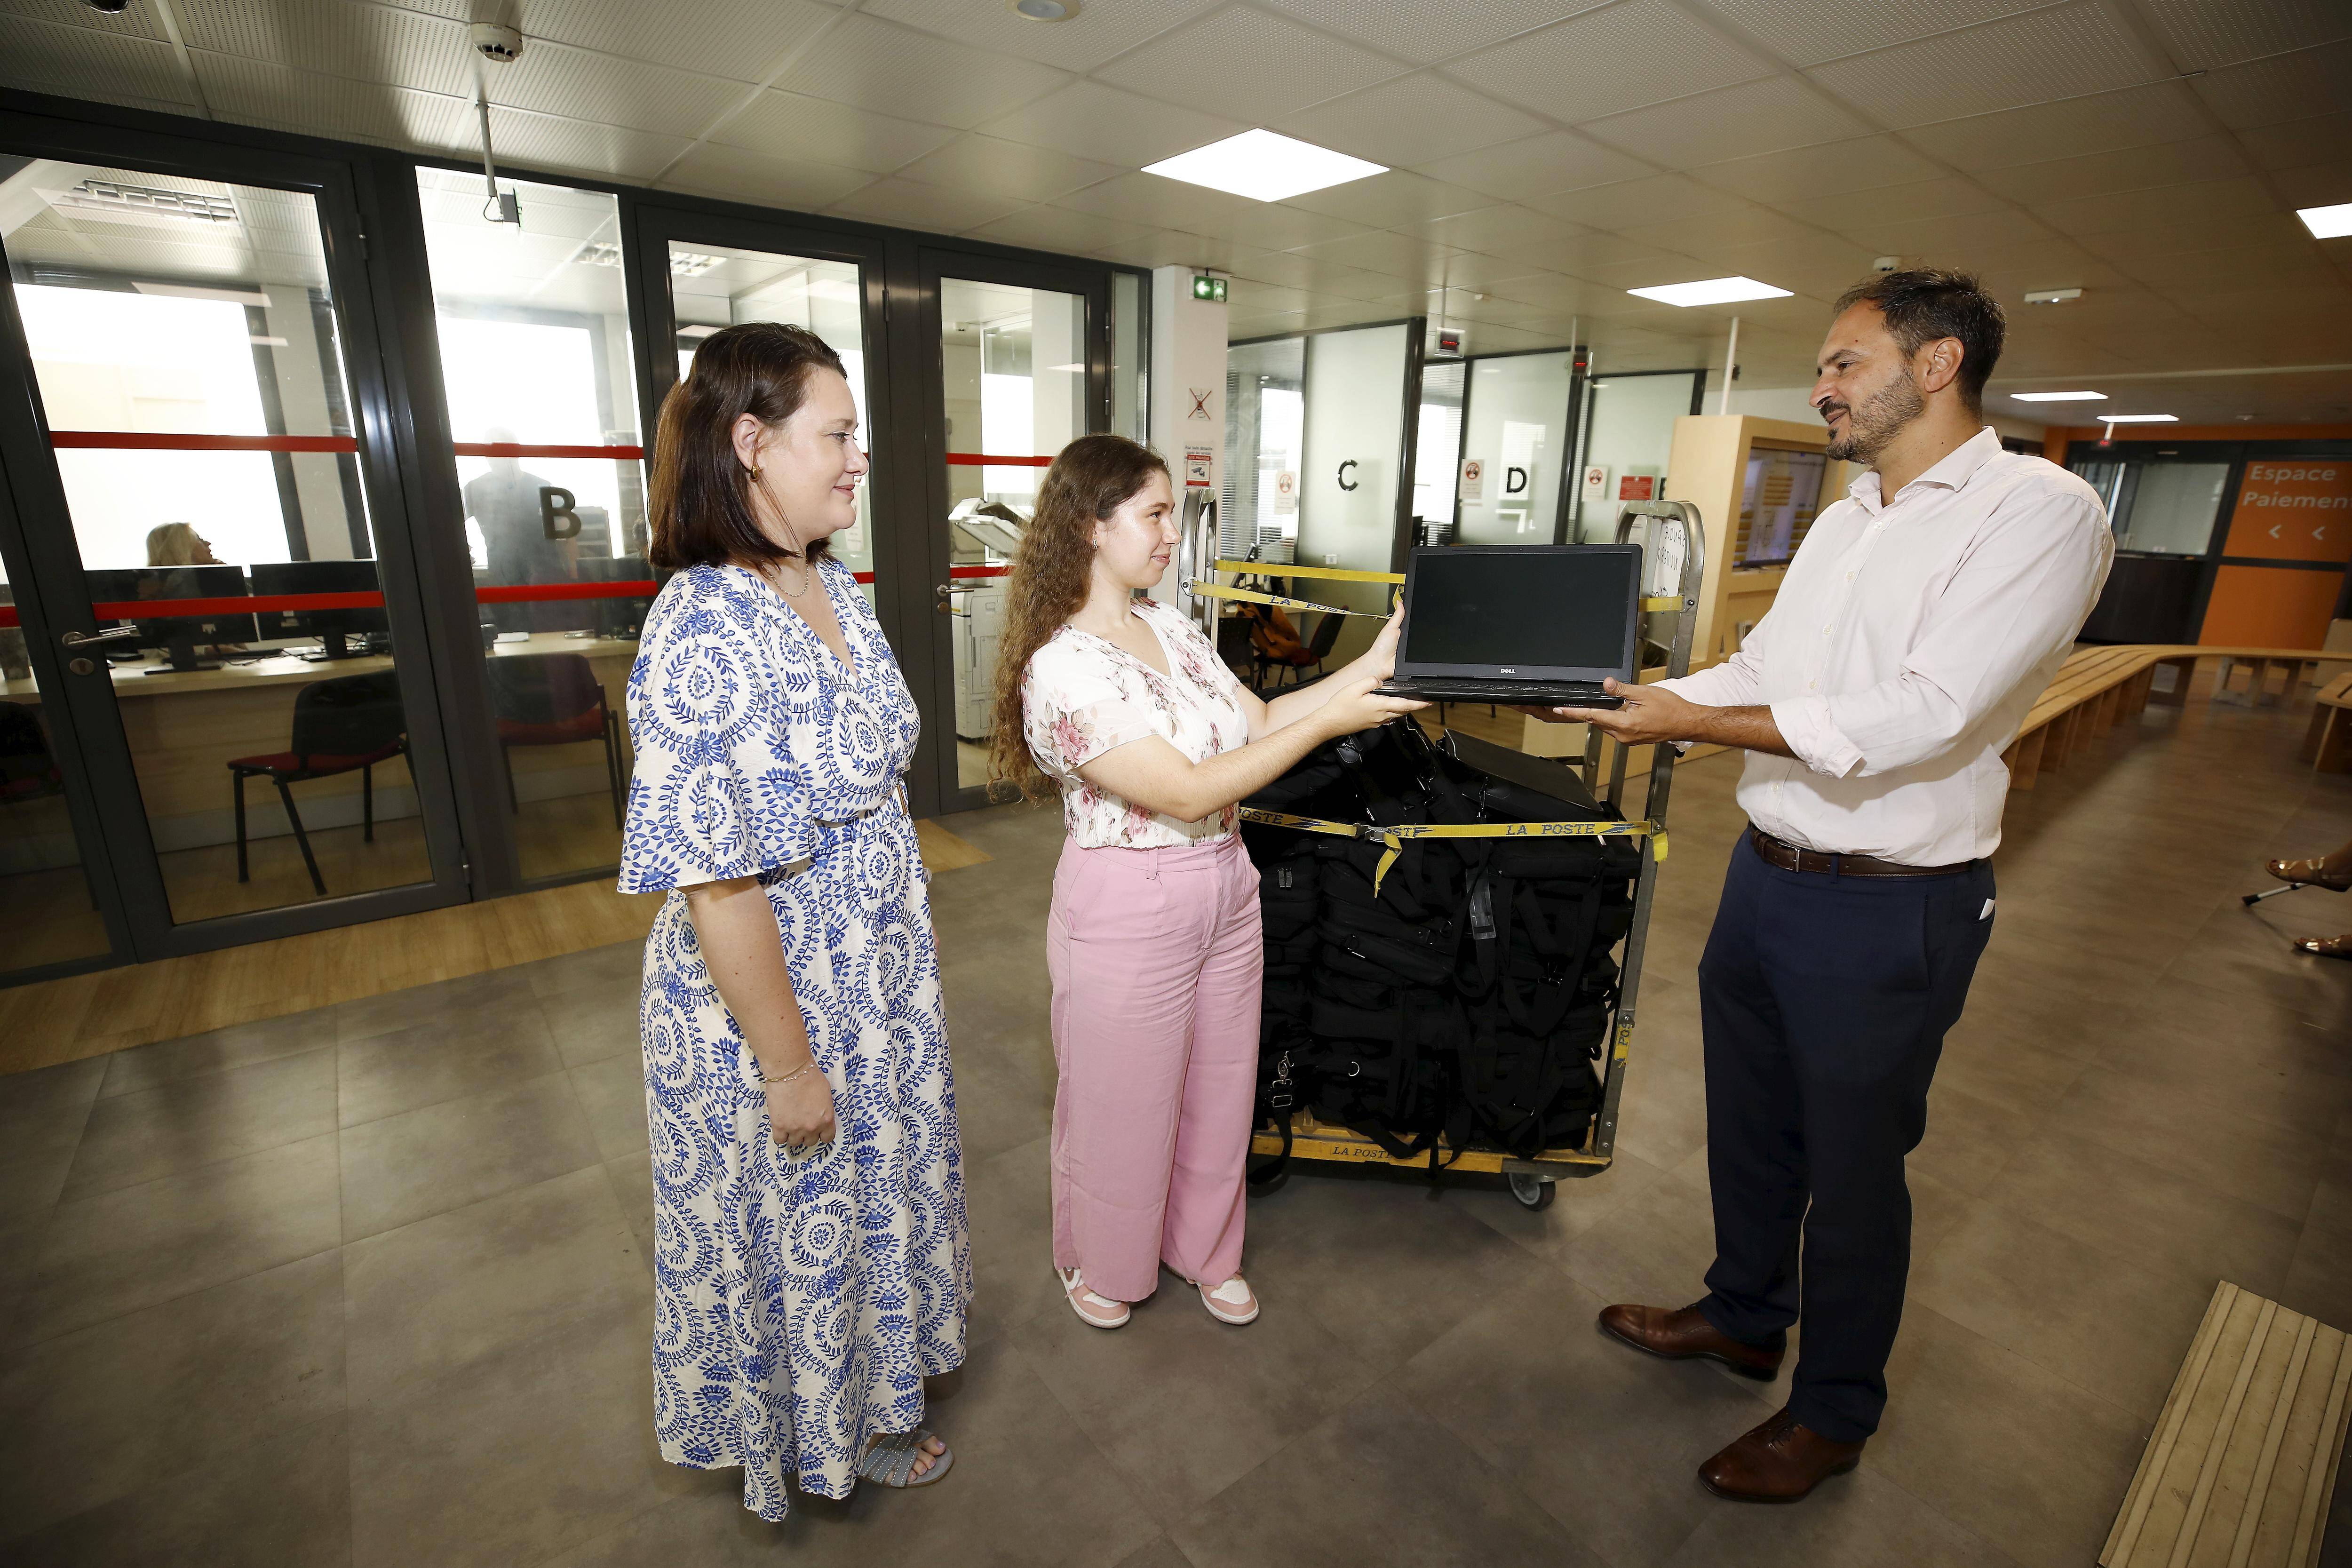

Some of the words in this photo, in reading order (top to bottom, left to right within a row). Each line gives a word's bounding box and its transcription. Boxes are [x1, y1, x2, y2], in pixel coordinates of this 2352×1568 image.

[1338, 459, 1359, 491] C
[1506, 467, 1527, 493] D
[2250, 465, 2336, 485] Espace
[540, 486, 581, 540] B
[1269, 596, 1291, 605] LA
[1505, 825, 1527, 836] LA
[1541, 823, 1596, 835] POSTE
[1332, 1146, 1349, 1155] LA
